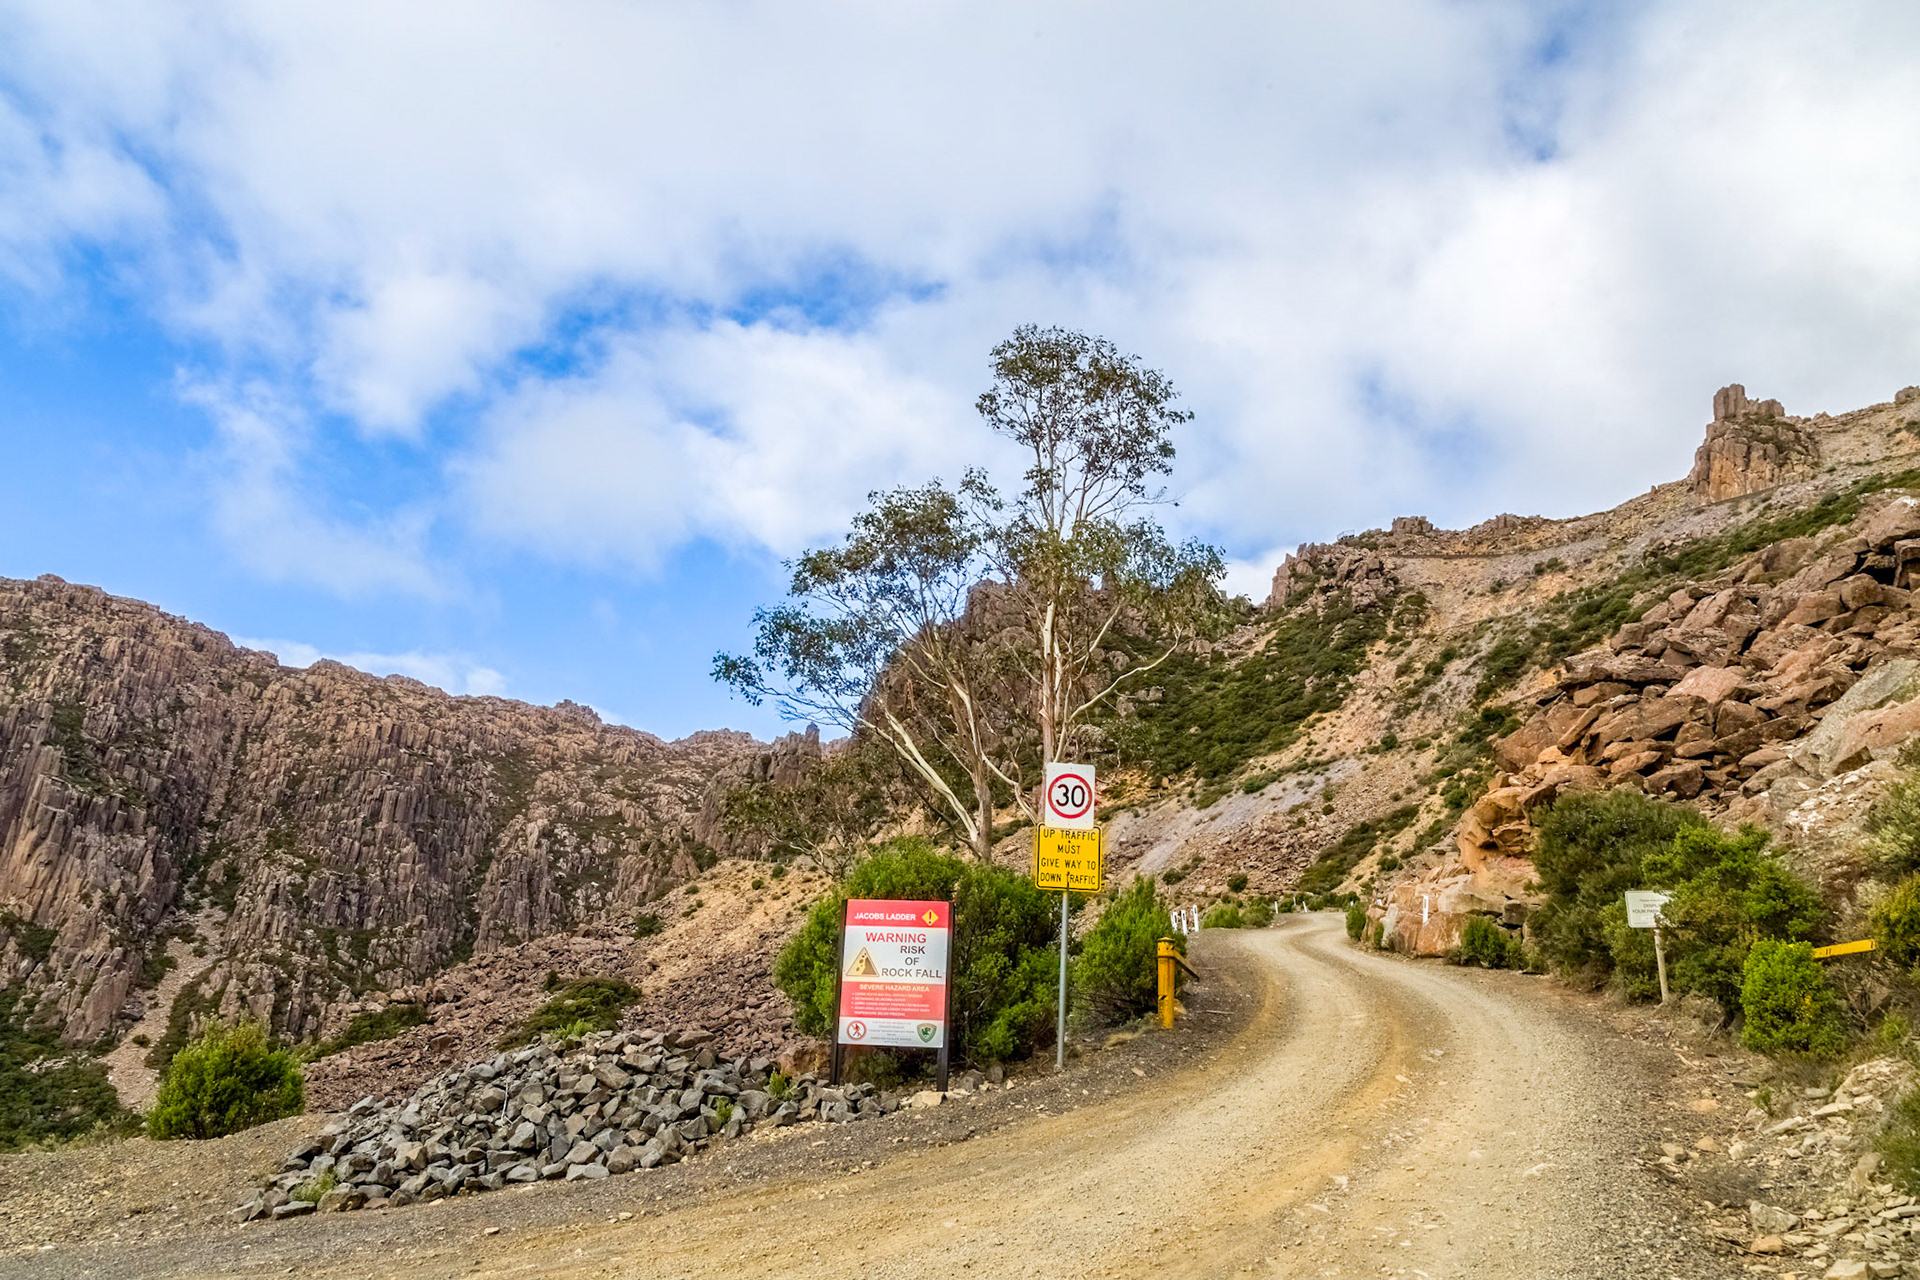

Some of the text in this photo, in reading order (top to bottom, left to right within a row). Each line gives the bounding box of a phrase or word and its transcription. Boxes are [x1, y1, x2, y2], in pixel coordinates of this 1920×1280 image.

[1056, 783, 1085, 808] 30
[1043, 829, 1096, 841] UP TRAFFIC
[1057, 844, 1080, 854] MUST
[1041, 858, 1096, 870] GIVE WAY TO
[1040, 872, 1061, 882] DOWN
[854, 912, 916, 921] JACOBS LADDER
[865, 931, 927, 943] WARNING
[900, 945, 926, 955] RISK
[904, 957, 920, 966] OF
[881, 968, 943, 979] ROCK FALL
